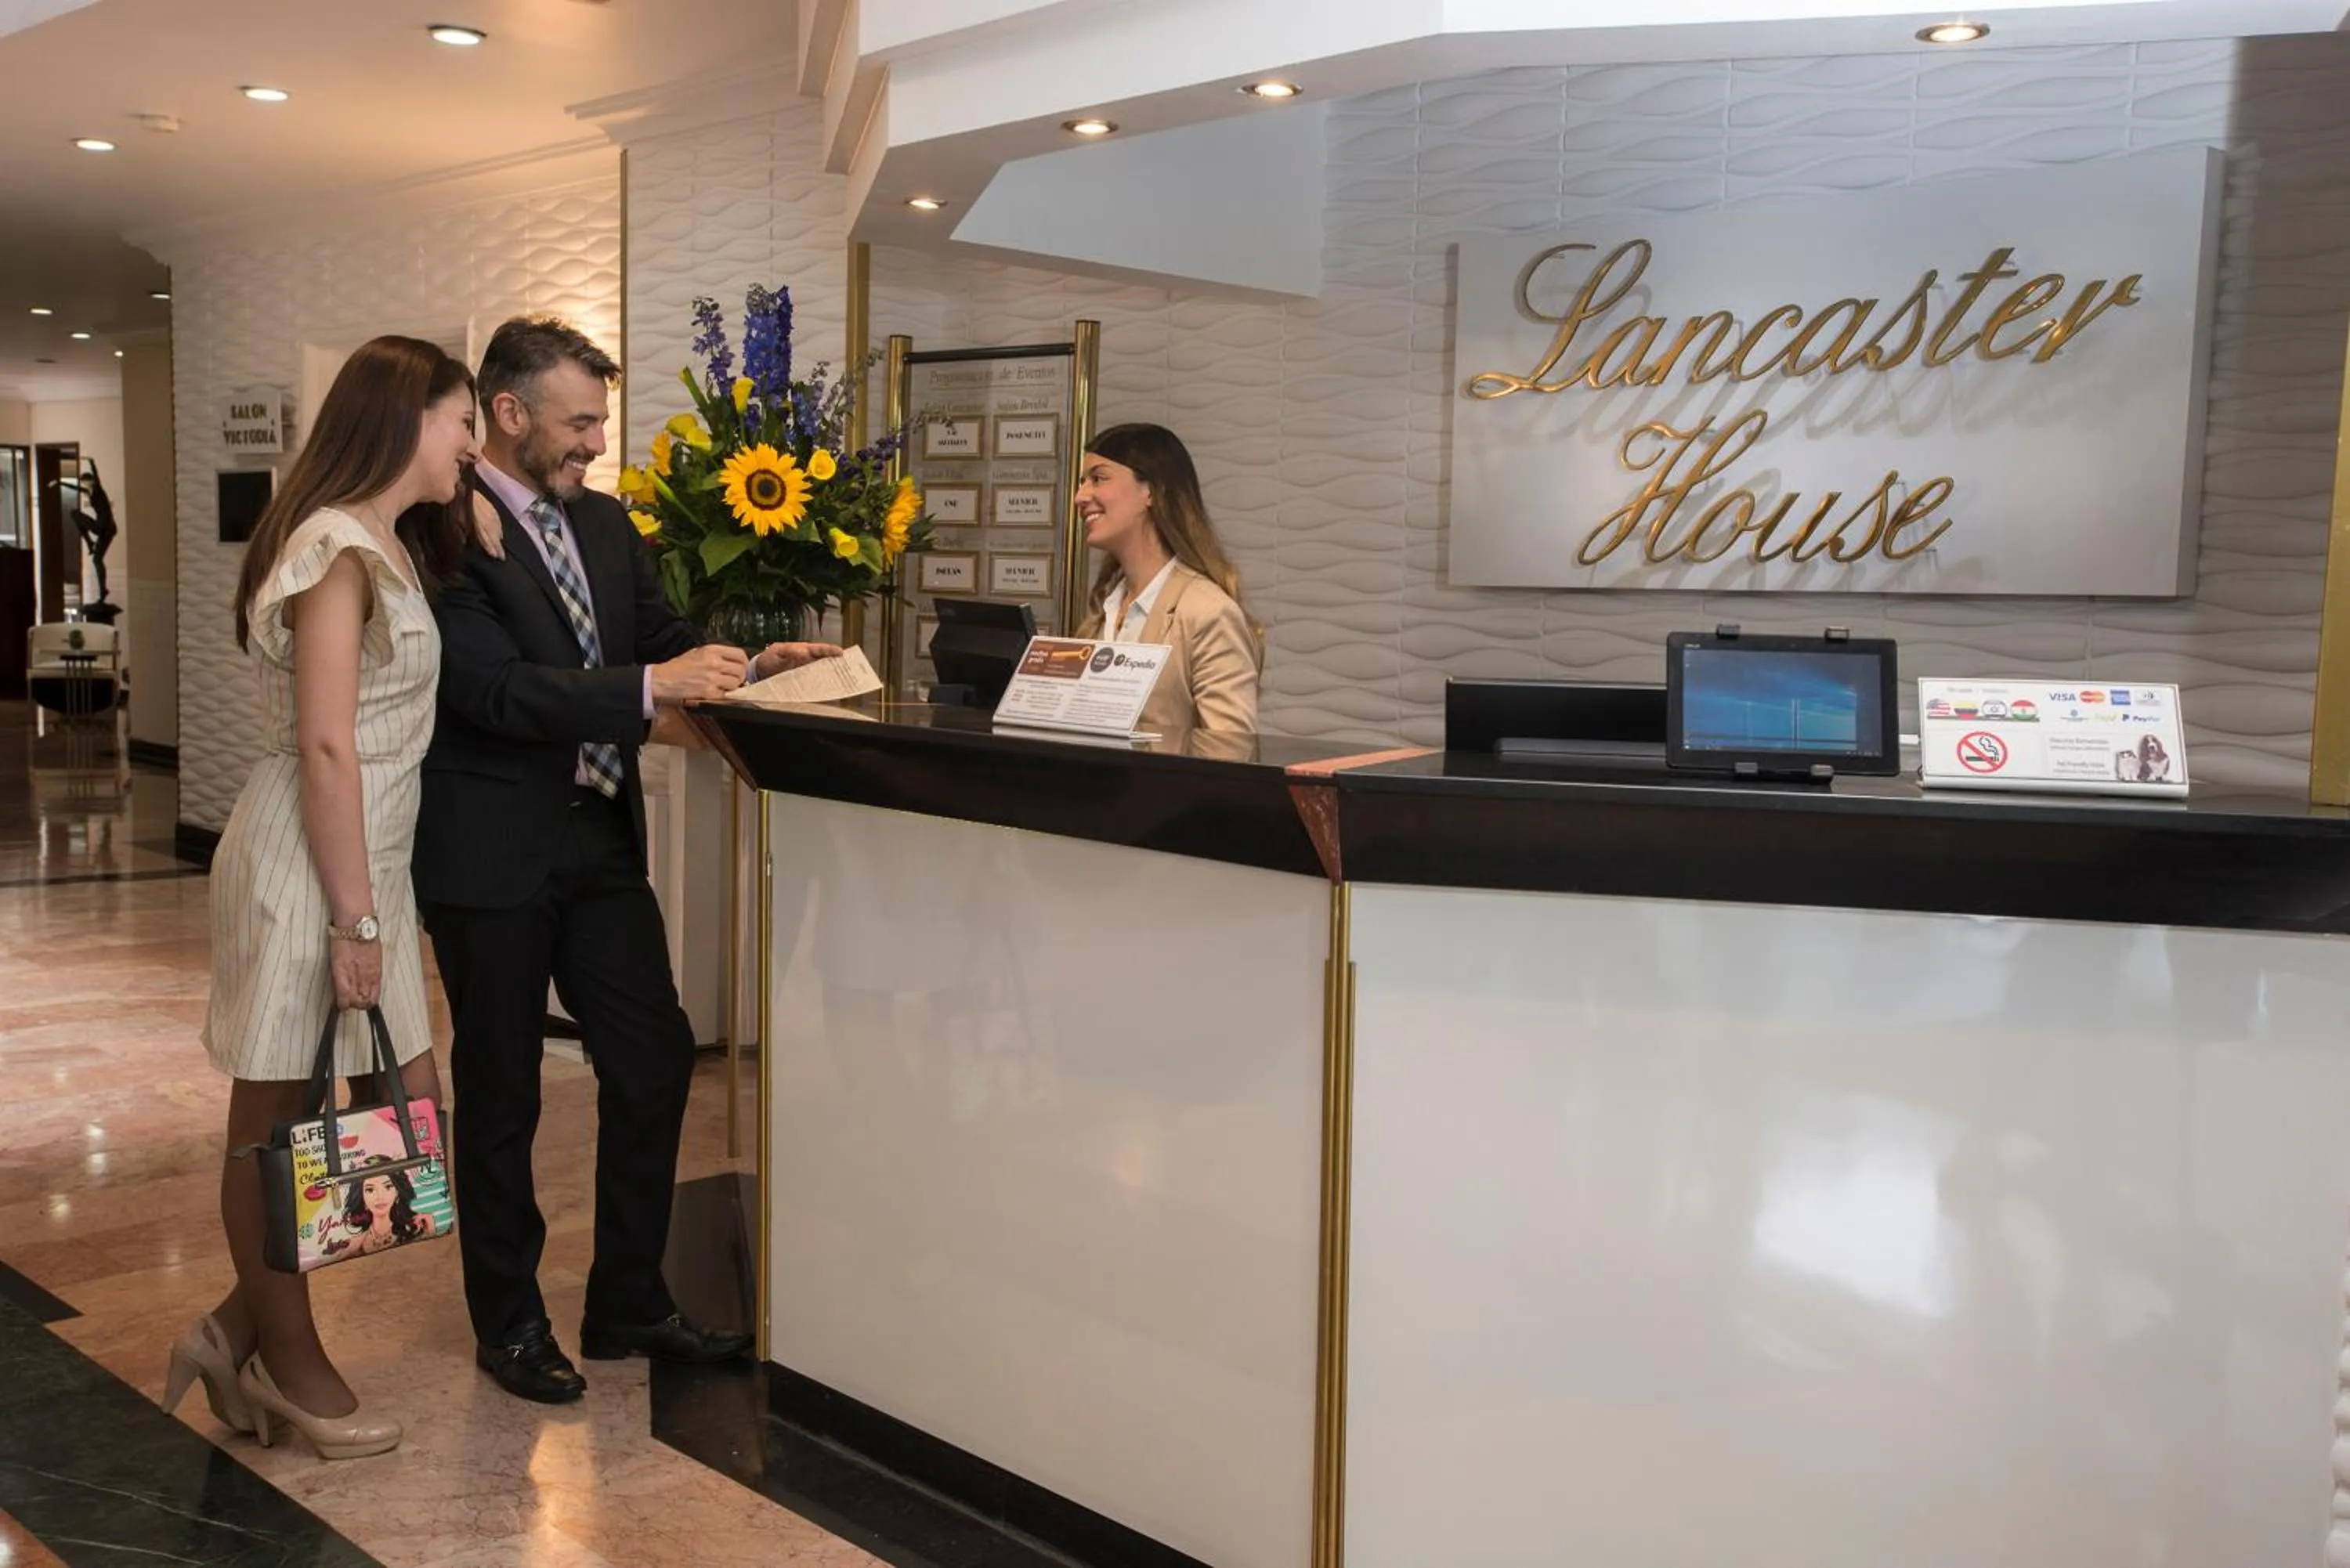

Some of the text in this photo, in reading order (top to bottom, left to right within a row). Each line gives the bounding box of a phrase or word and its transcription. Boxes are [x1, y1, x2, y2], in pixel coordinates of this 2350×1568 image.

[1467, 239, 2143, 401] Lancaster
[1576, 409, 1955, 566] House
[2049, 692, 2076, 702] VISA
